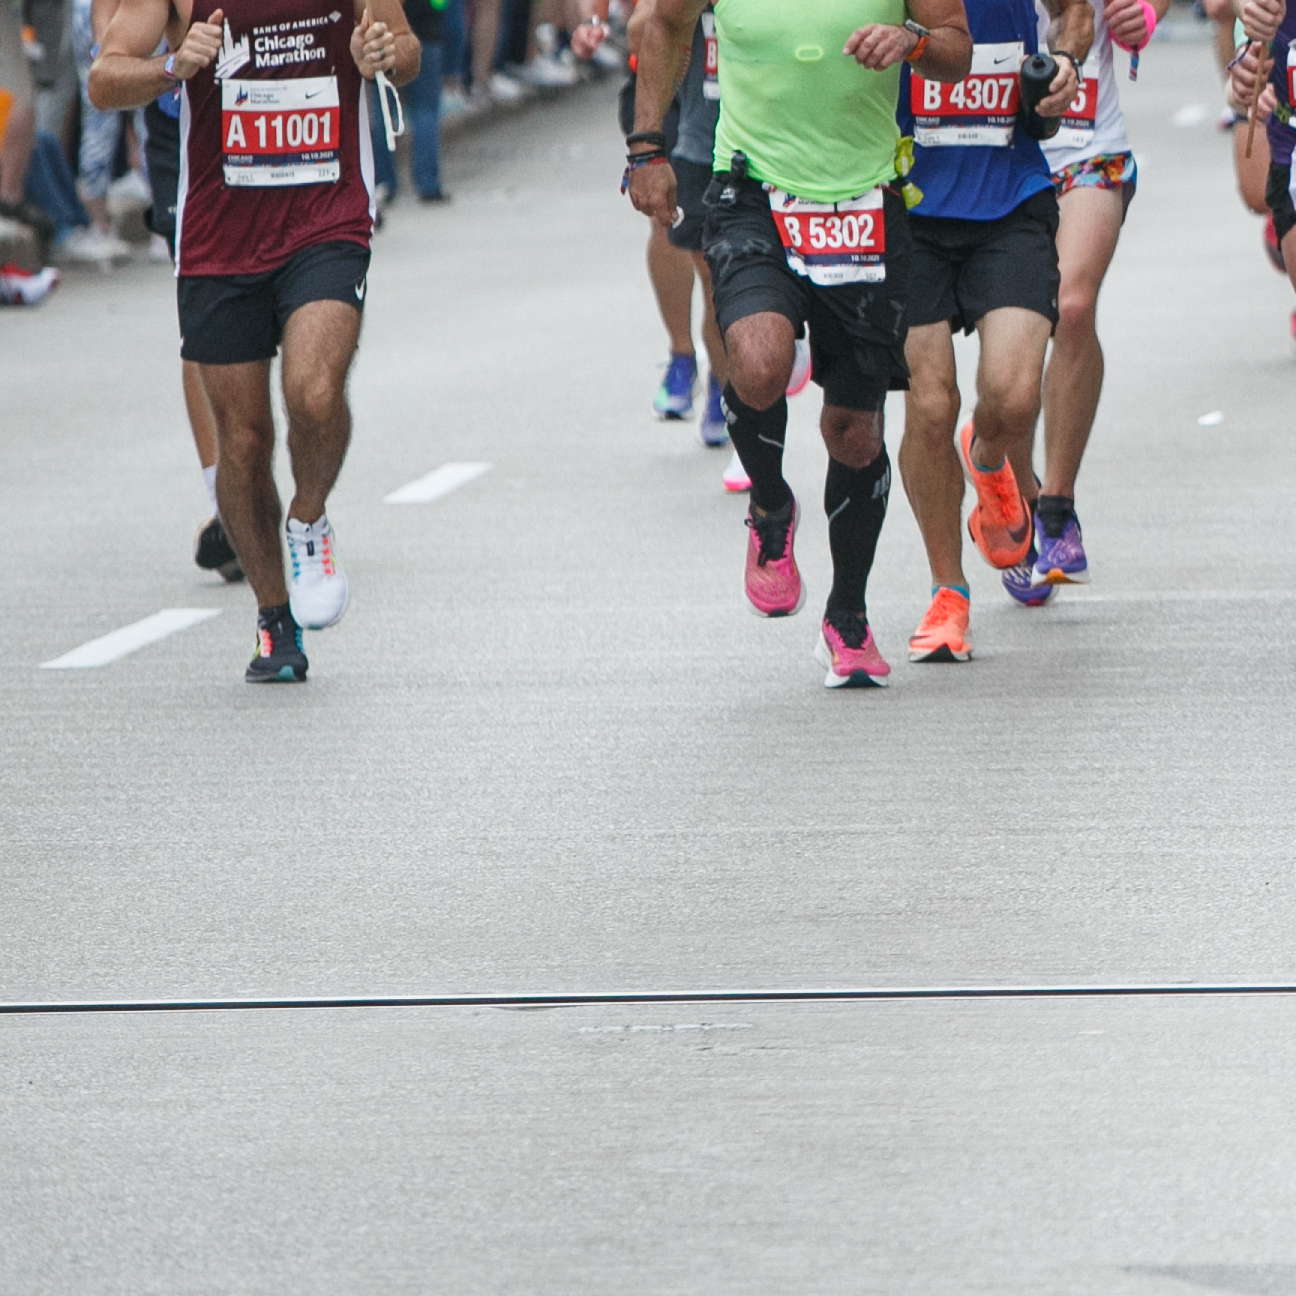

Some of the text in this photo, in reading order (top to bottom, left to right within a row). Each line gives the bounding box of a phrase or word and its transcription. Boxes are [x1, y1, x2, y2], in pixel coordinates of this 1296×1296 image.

[252, 16, 329, 36] BANK OF AMERICA
[254, 33, 314, 52] Chicago
[255, 47, 326, 68] Marathon
[923, 78, 1014, 111] B 4307
[226, 111, 331, 148] A 11001
[301, 151, 334, 160] 10.10.2021
[784, 213, 875, 249] B 5302
[851, 254, 880, 262] 10.10.2021
